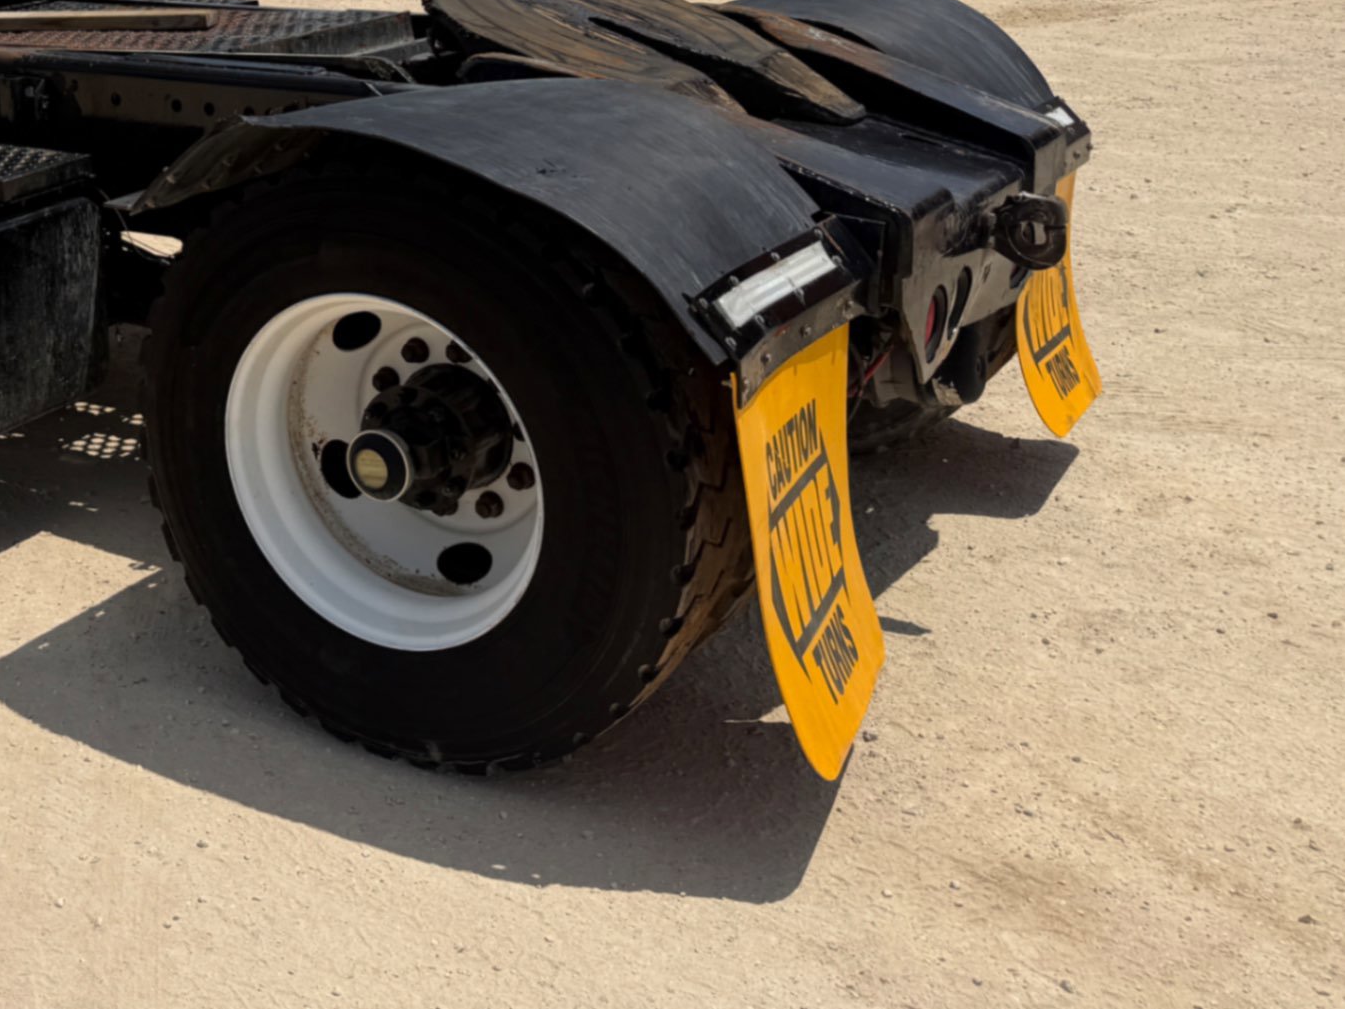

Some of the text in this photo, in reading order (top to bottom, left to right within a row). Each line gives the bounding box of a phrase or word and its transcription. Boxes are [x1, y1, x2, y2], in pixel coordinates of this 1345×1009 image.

[765, 398, 819, 501] CAUTION
[770, 463, 843, 644] WIDE
[812, 604, 859, 705] TURNS
